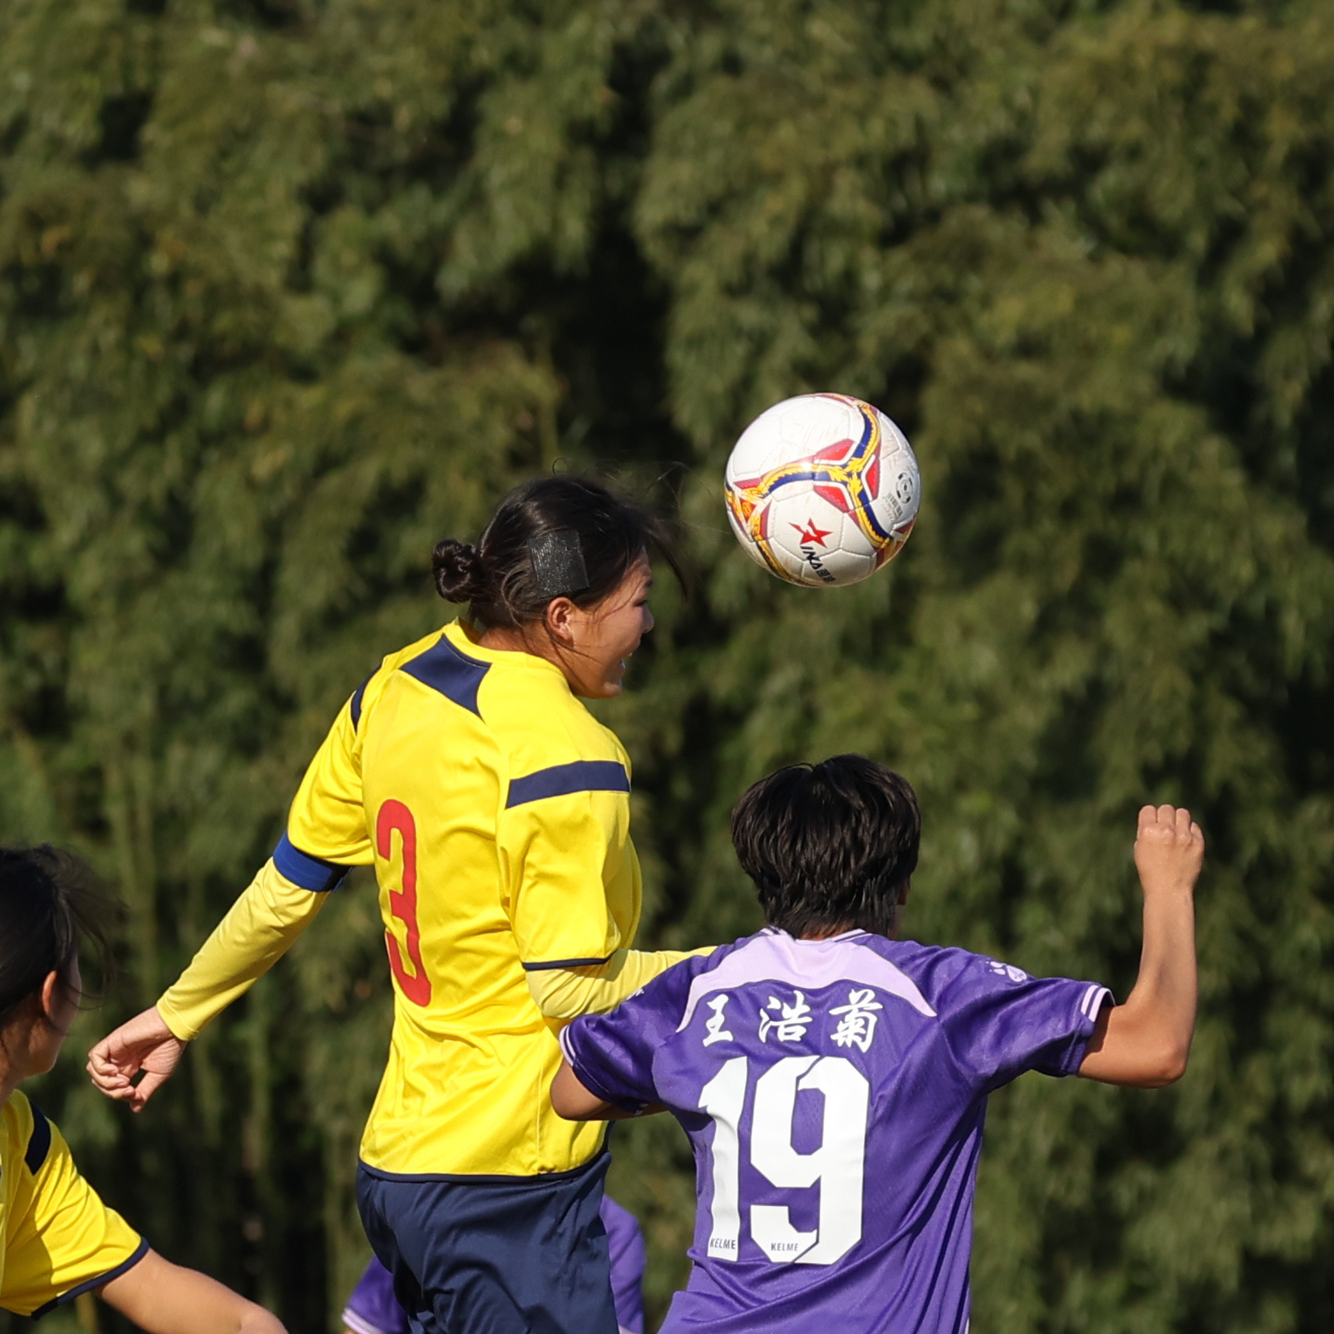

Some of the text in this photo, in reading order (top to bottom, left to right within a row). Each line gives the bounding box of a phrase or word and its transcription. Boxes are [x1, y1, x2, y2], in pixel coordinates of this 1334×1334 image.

[376, 799, 432, 1007] 3
[698, 1055, 870, 1265] 19
[709, 1237, 737, 1250] KELME
[770, 1242, 799, 1252] KELME
